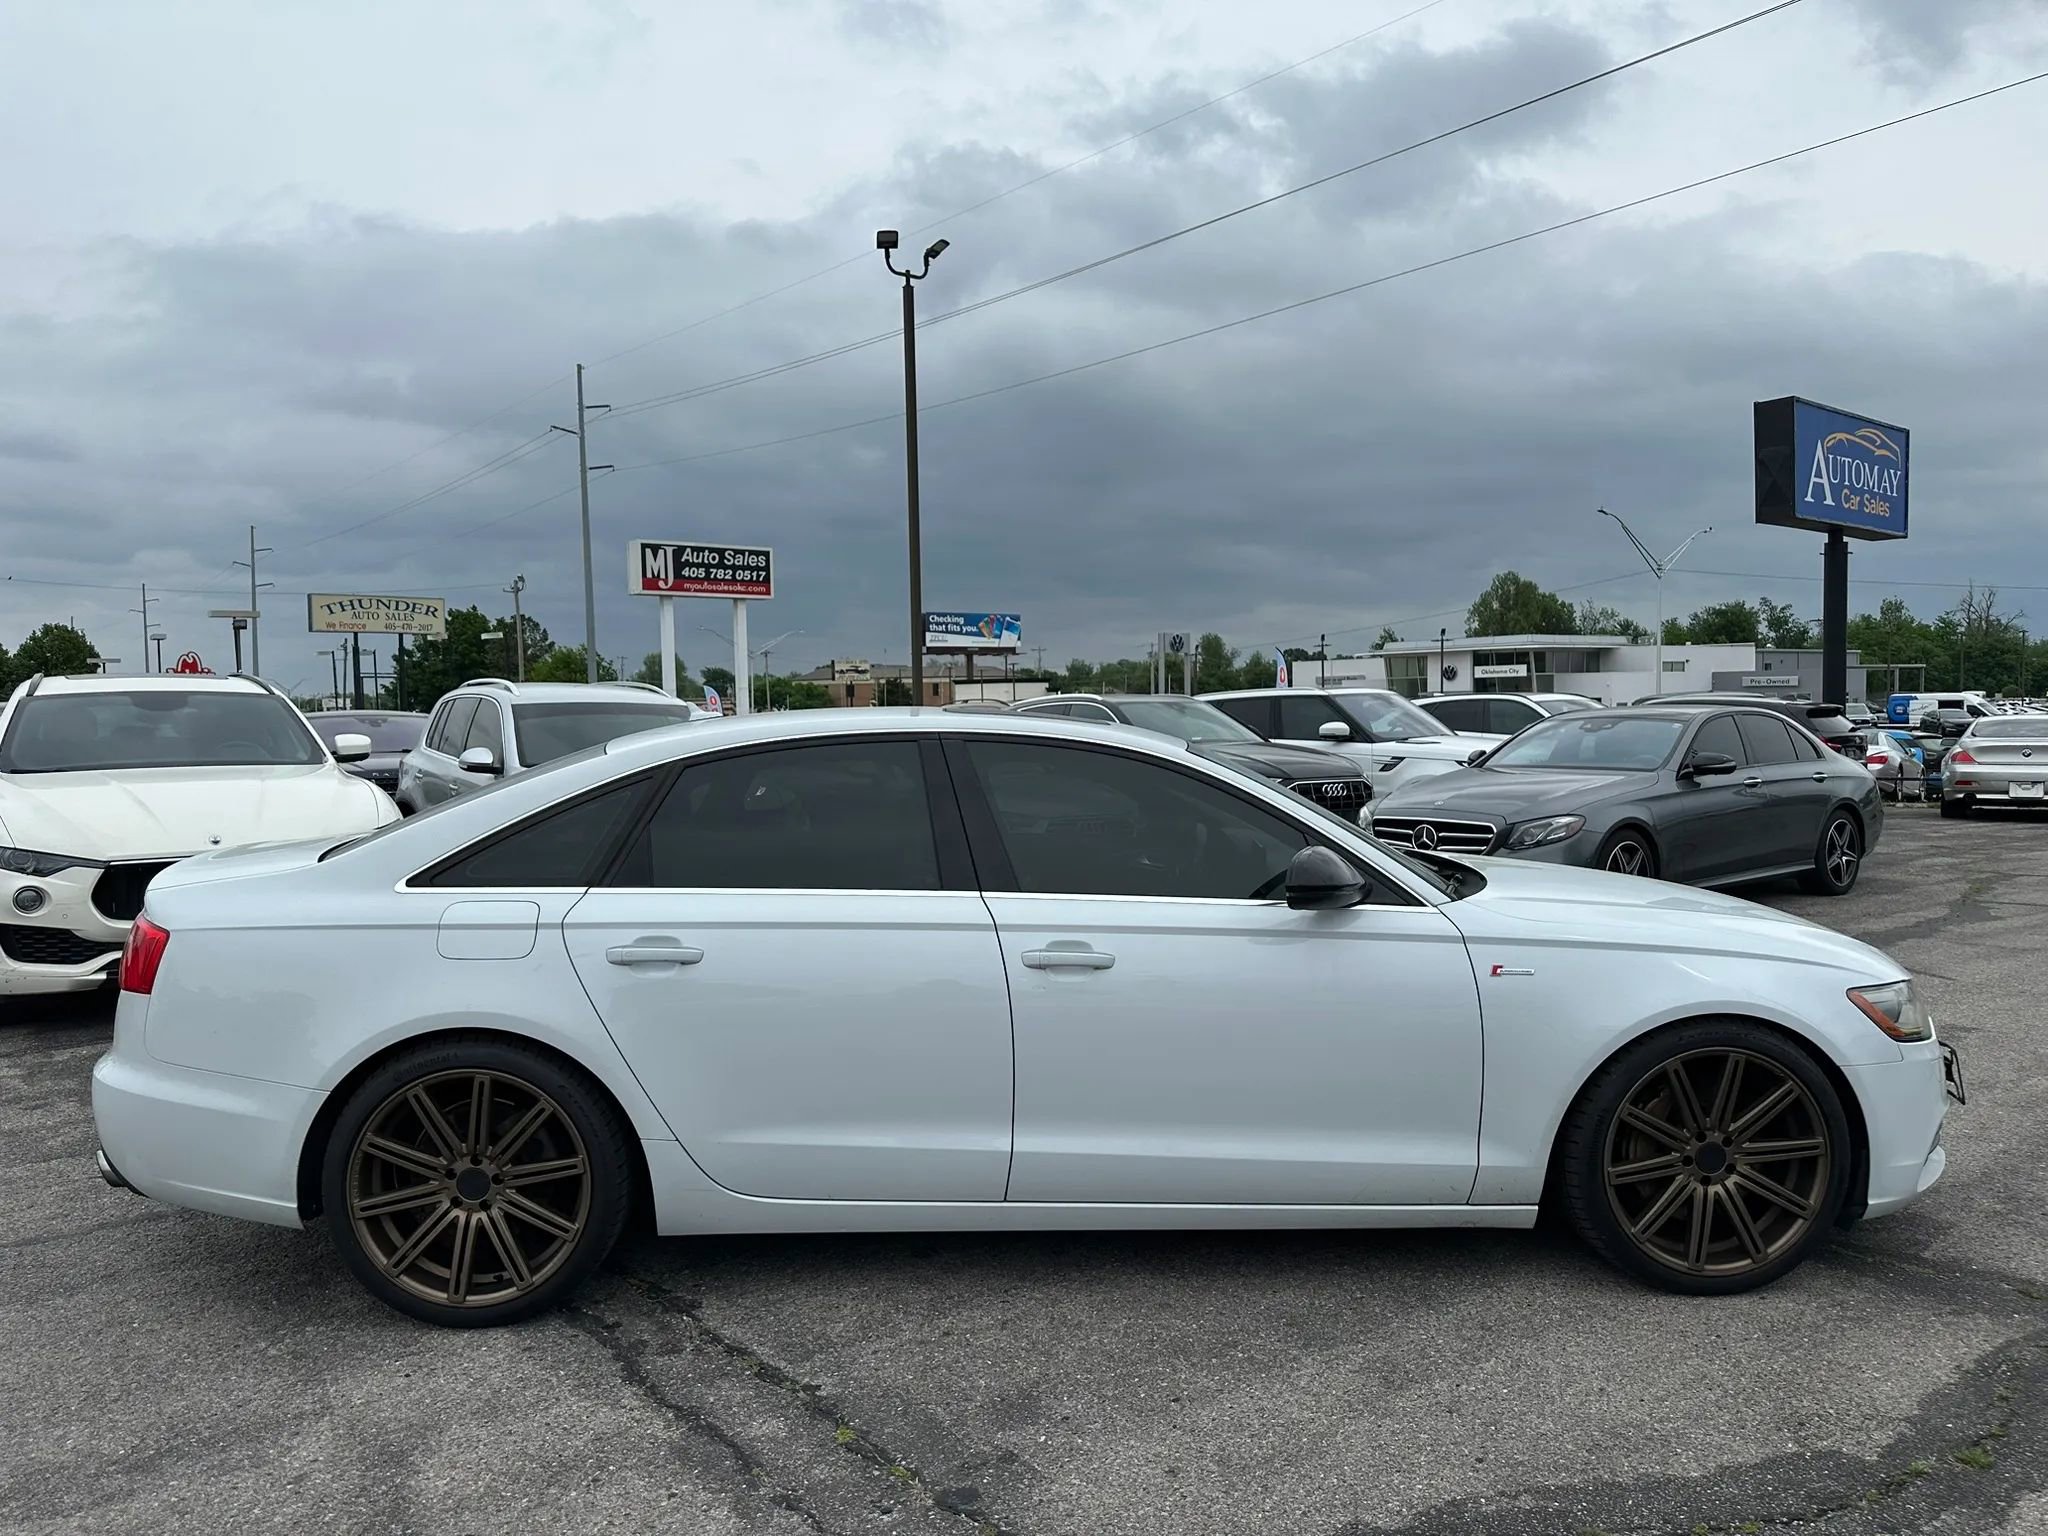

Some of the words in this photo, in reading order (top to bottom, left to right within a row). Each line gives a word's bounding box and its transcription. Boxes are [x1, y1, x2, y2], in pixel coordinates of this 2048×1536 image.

[1805, 440, 1901, 506] AUTOMAY
[1841, 489, 1860, 510] Car
[1864, 495, 1890, 517] Sales
[681, 548, 719, 564] Auto
[724, 550, 767, 567] Sales
[645, 546, 678, 589] MJ
[681, 567, 706, 578] 405
[710, 568, 732, 580] 782
[735, 570, 767, 582] 0517
[320, 598, 439, 619] THUNDER
[351, 611, 380, 621] AUTO
[385, 612, 415, 622] SALES
[325, 621, 337, 629] We
[339, 621, 367, 630] Finance
[384, 622, 433, 632] 405-470-2017
[929, 614, 965, 625] Checking
[930, 623, 946, 632] that
[948, 623, 961, 632] fits
